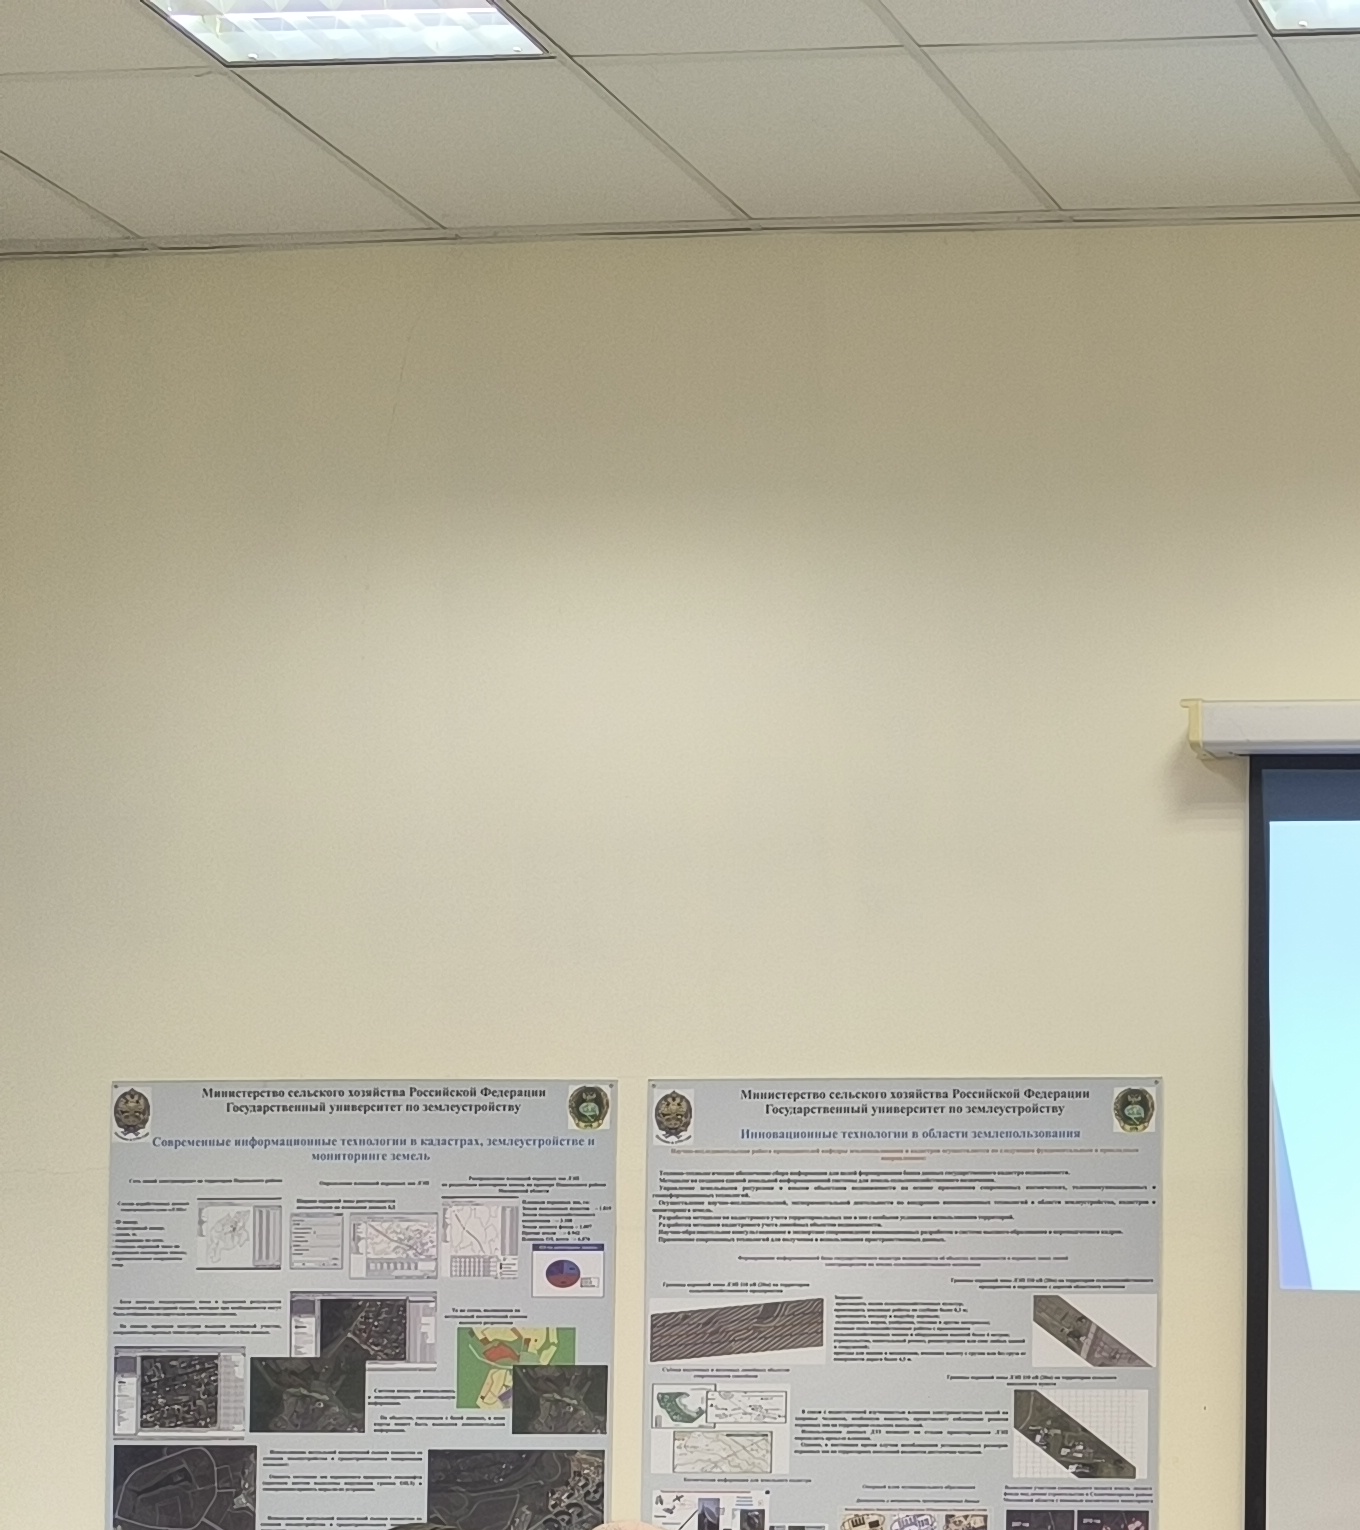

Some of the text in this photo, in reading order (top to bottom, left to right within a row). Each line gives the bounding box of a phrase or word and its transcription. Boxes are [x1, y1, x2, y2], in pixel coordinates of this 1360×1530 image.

[202, 1088, 285, 1100] Министерство
[348, 1088, 405, 1097] хозяйства
[410, 1087, 476, 1097] Российской
[480, 1087, 545, 1099] Федерации
[741, 1090, 826, 1102] Министерство
[891, 1089, 948, 1099] хозяйства
[953, 1089, 1020, 1098] Российской
[1024, 1089, 1089, 1101] Федерации
[227, 1102, 325, 1115] Государственный
[329, 1104, 403, 1114] университет
[423, 1102, 521, 1114] землеустройству
[766, 1104, 867, 1116] Государственный
[871, 1106, 945, 1116] университет
[966, 1103, 1064, 1116] землеустройству
[741, 1129, 838, 1139] Инновационные
[922, 1128, 968, 1138] области
[152, 1137, 231, 1149] Современные
[235, 1137, 337, 1149] информационные
[421, 1139, 483, 1148] кадастрах,
[487, 1136, 584, 1148] землеустройстве
[312, 1153, 385, 1163] мониторинге
